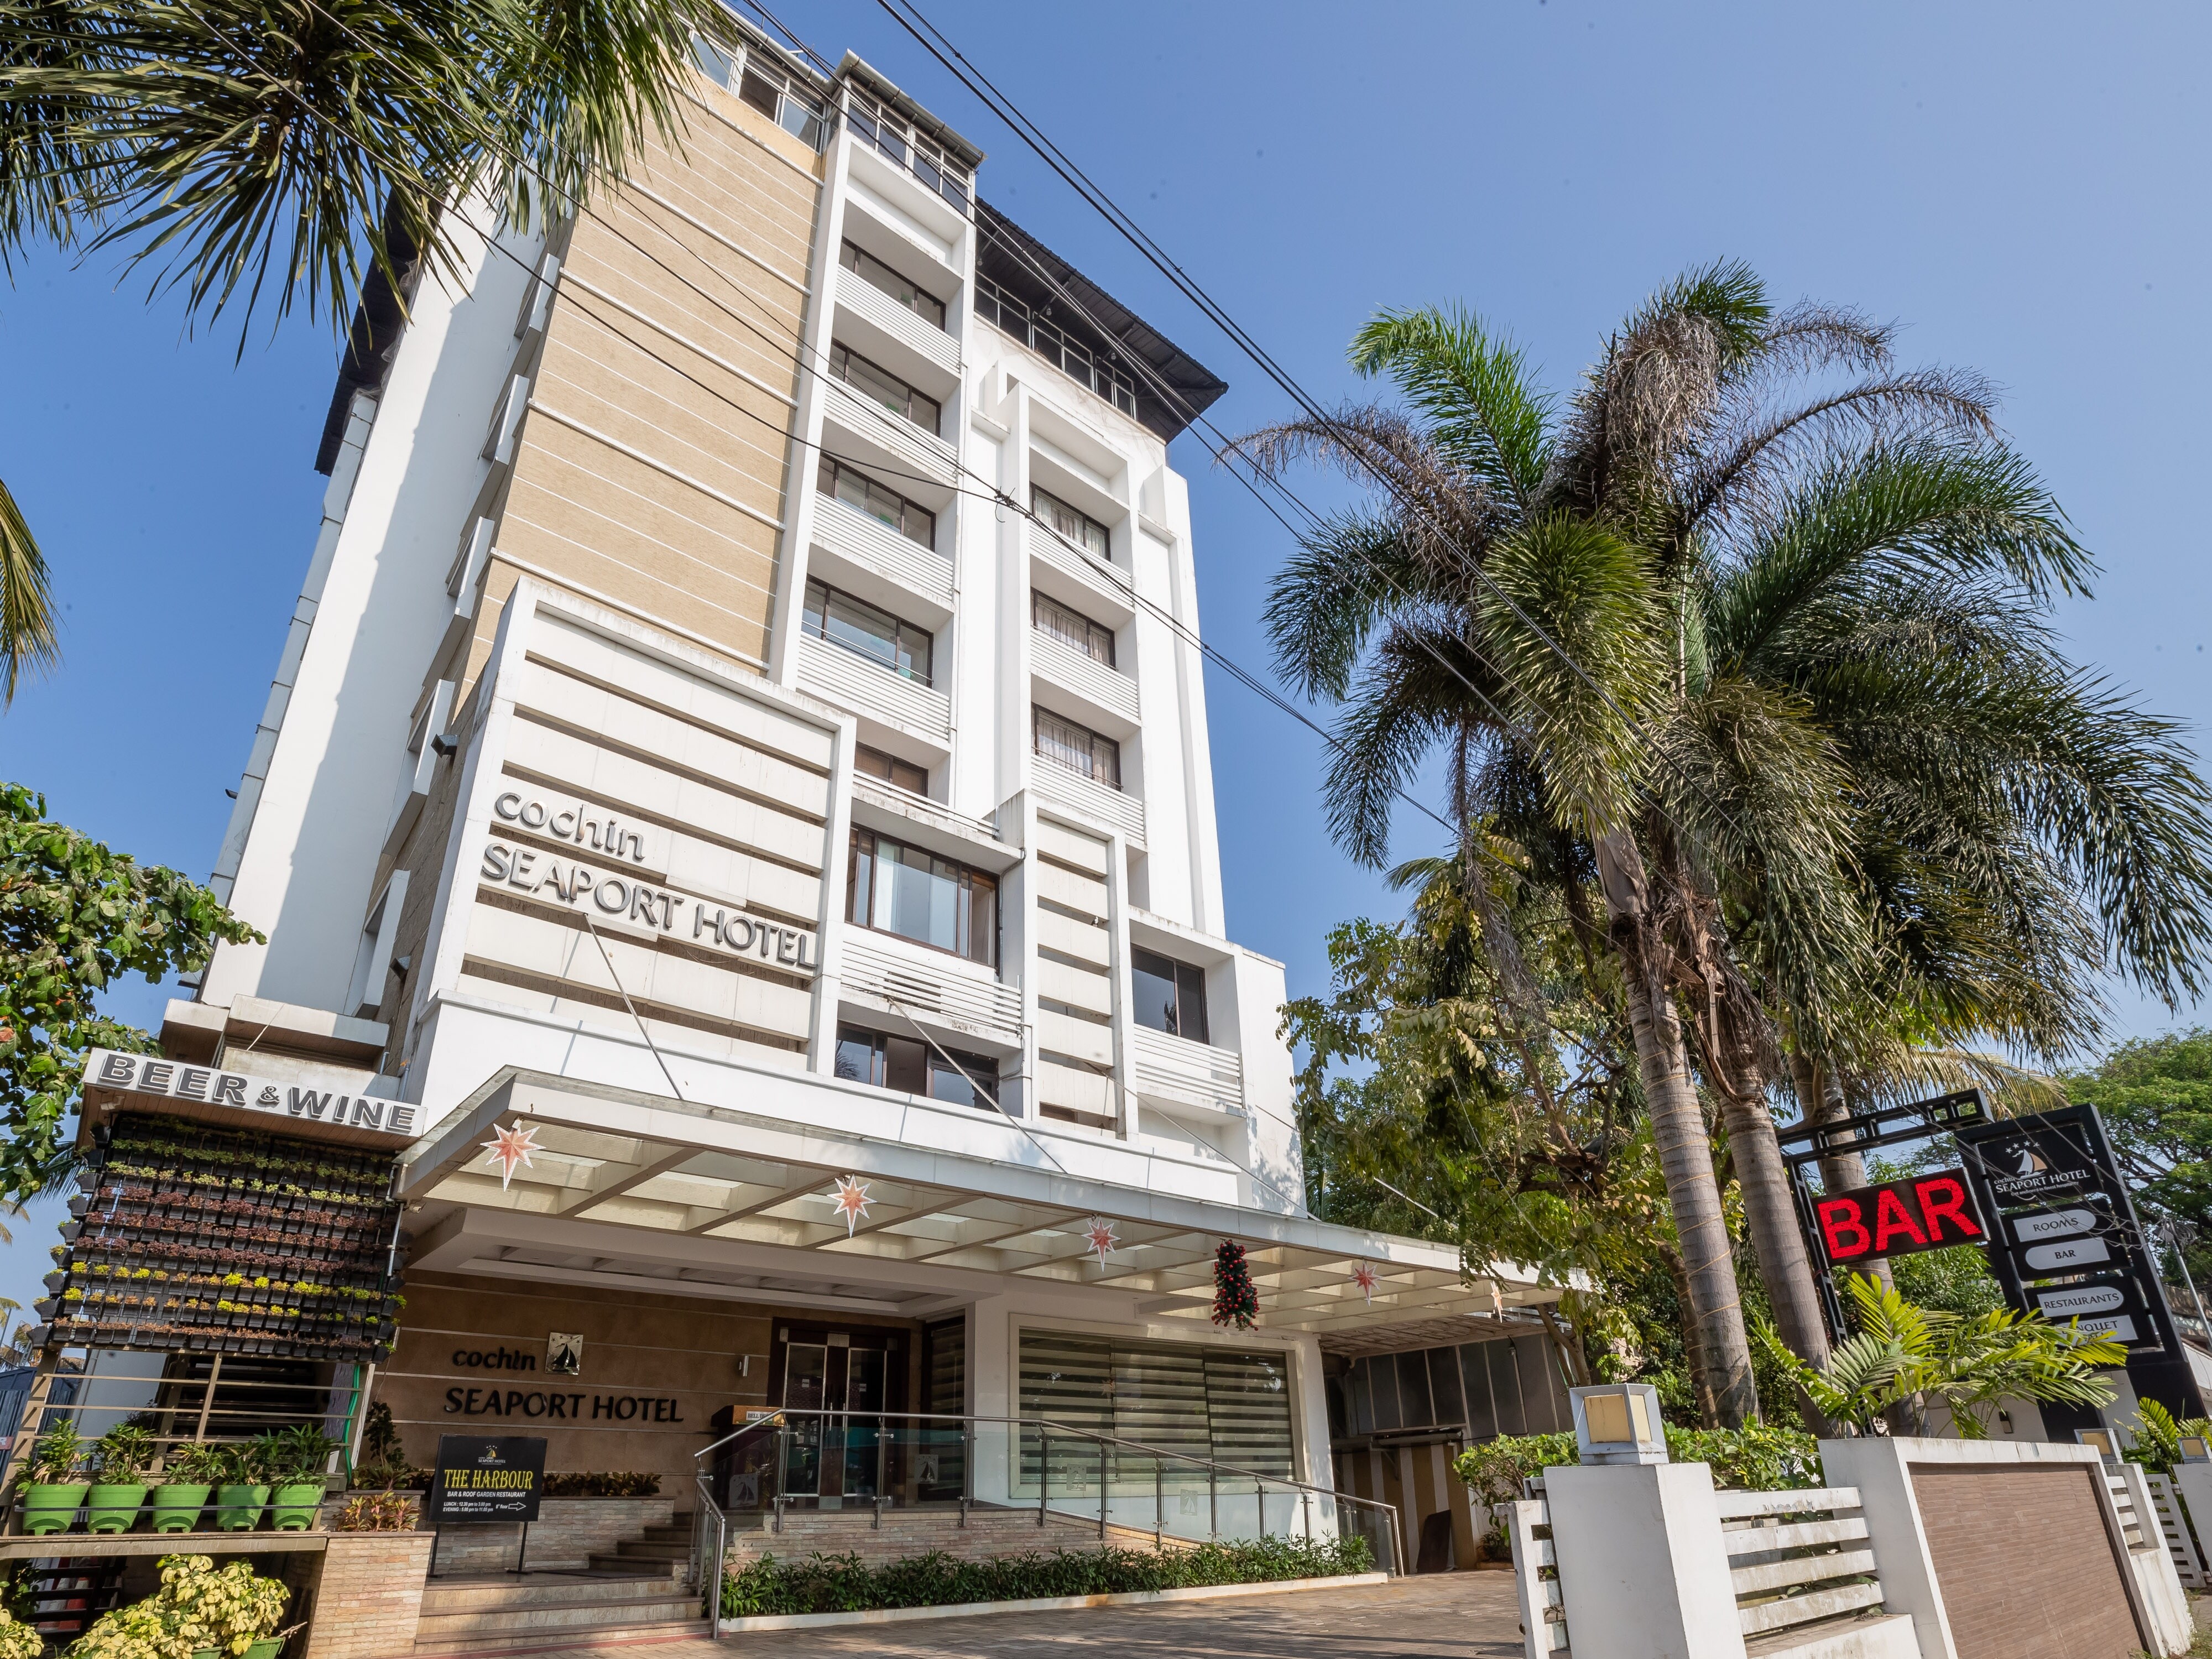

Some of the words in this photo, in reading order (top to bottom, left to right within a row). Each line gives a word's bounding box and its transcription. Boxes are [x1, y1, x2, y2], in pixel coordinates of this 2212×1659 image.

[495, 792, 646, 862] cochin
[481, 843, 685, 928] SEAPORT
[693, 904, 818, 969] HOTEL
[99, 1053, 247, 1105] BEER
[259, 1085, 280, 1105] &
[290, 1087, 416, 1131] WINE
[1995, 1176, 2047, 1193] SEAPORT
[2049, 1169, 2091, 1183] HOTEL
[1817, 1177, 1982, 1259] BAR
[2032, 1217, 2079, 1233] ROOMS
[2054, 1249, 2077, 1260] BAR
[2043, 1292, 2120, 1310] RESTAURANTS
[2062, 1320, 2118, 1334] NQUET
[452, 1347, 536, 1371] cochin
[444, 1387, 586, 1418] SEAPORT
[592, 1395, 684, 1423] HOTEL
[445, 1469, 470, 1489] THE
[472, 1469, 533, 1490] HARBOUR
